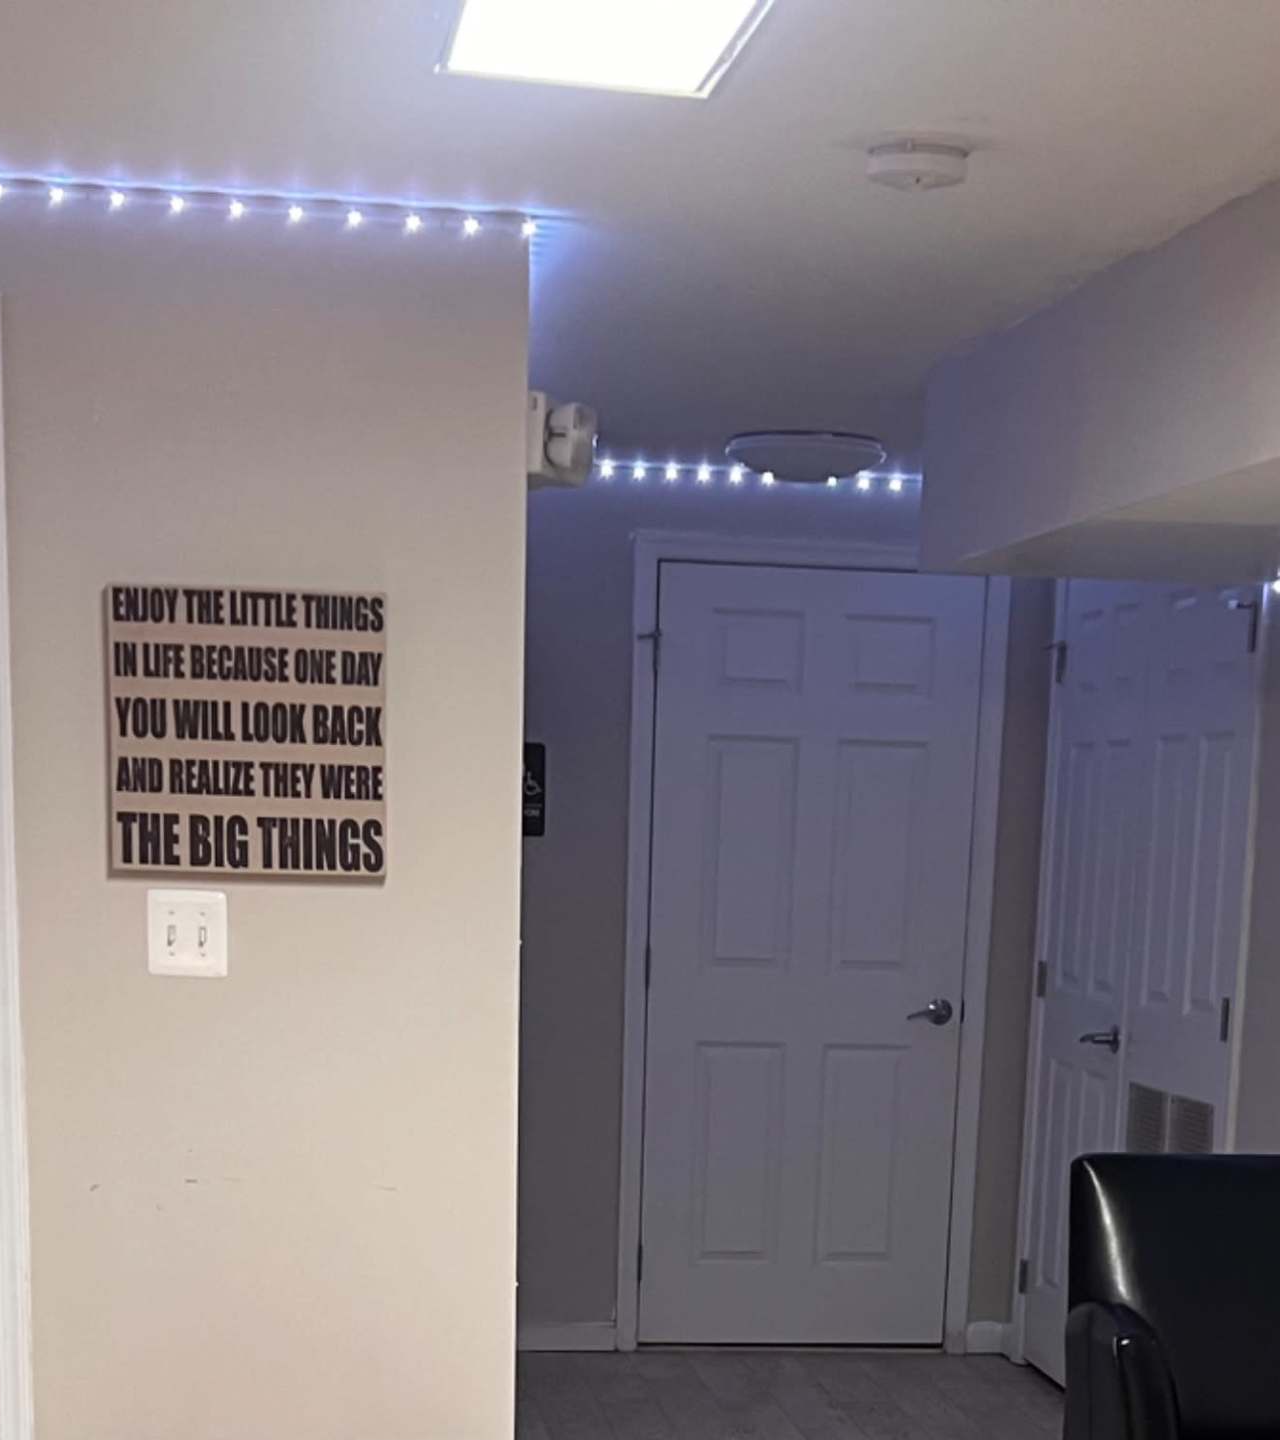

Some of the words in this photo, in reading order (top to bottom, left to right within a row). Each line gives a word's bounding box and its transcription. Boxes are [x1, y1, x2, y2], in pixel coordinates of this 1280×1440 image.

[112, 586, 179, 623] ENJOY
[183, 589, 224, 625] THE
[230, 590, 297, 628] LITTLE
[302, 593, 384, 633] THINGS
[114, 642, 137, 677] IN
[143, 642, 185, 679] LIFE
[190, 644, 289, 684] BECAUSE
[294, 649, 337, 685] ONE
[342, 651, 383, 686] DAY
[115, 697, 166, 739] YOU
[173, 699, 235, 742] WILL
[241, 702, 306, 744] LOOK
[313, 705, 382, 746] BACK
[117, 757, 163, 793] AND
[169, 759, 255, 797] REALIZE
[260, 762, 315, 799] THEY
[320, 764, 383, 801] WERE
[117, 811, 180, 865] THE
[189, 814, 249, 868] BIG
[257, 816, 384, 872] THINGS
